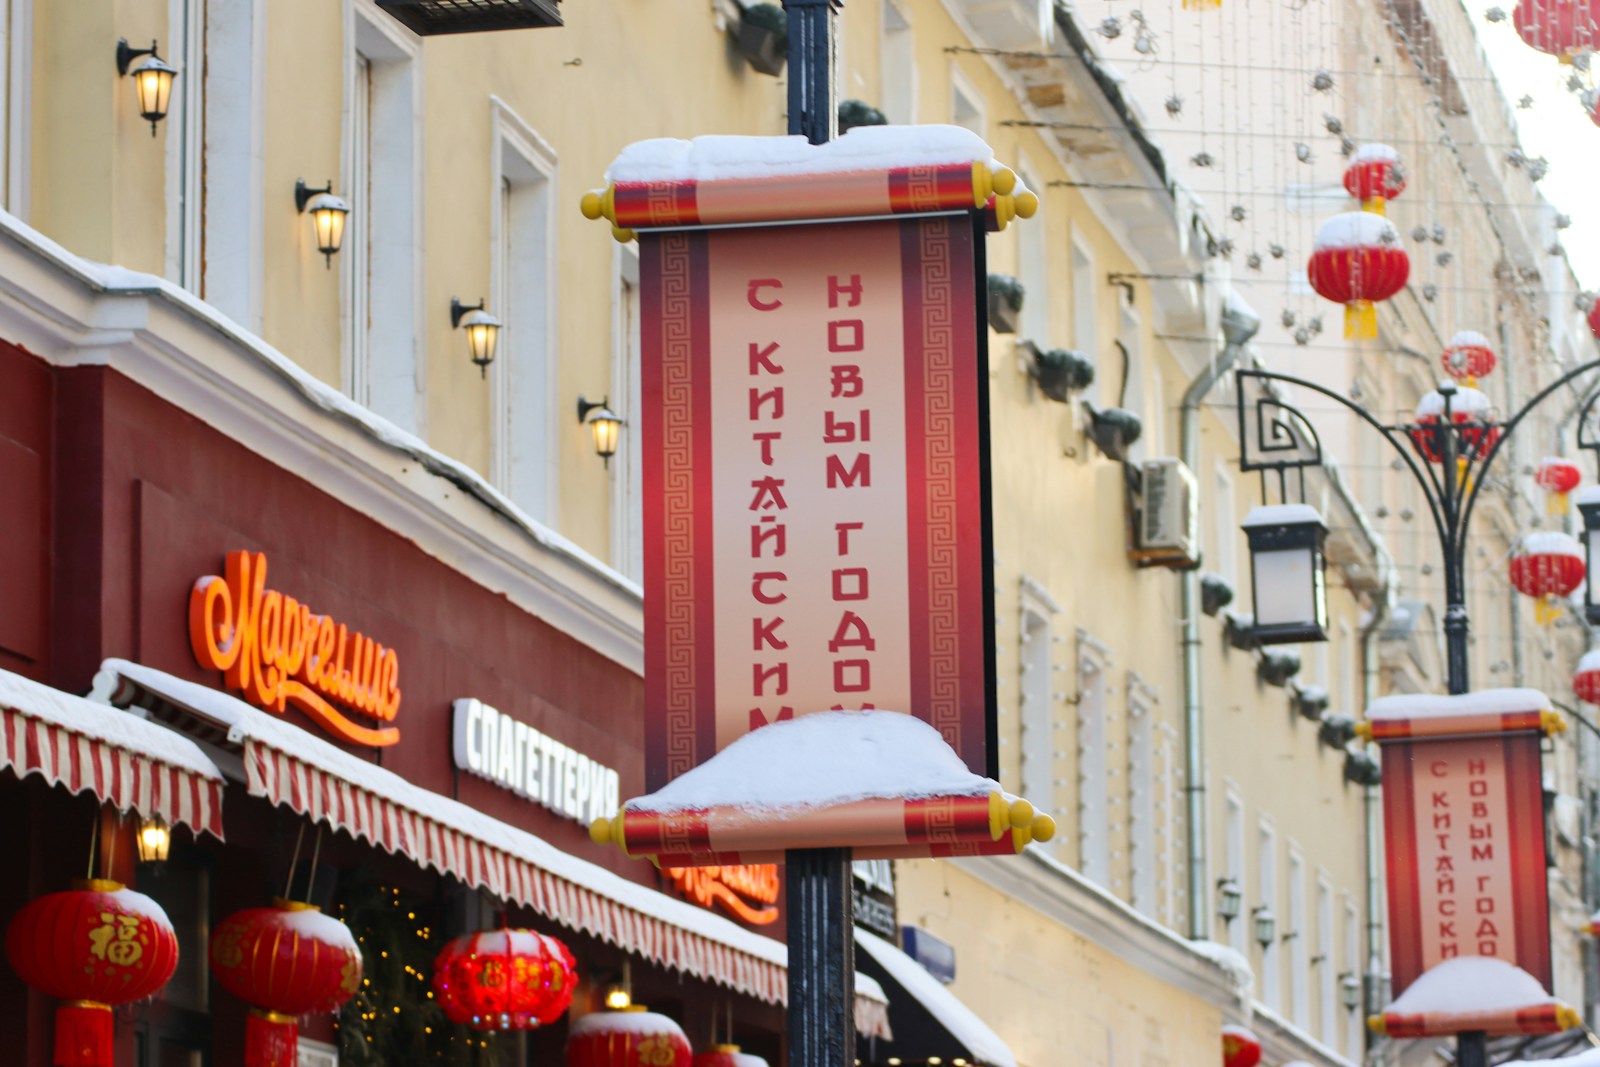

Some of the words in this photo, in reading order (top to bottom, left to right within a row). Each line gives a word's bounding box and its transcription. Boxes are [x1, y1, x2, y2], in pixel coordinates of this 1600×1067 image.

[747, 278, 783, 311] С
[823, 274, 871, 488] НОВЫМ
[828, 521, 876, 714] ГОДО
[454, 697, 619, 827] СПАГЕТТЕРИЯ
[1430, 761, 1448, 778] С
[1468, 758, 1493, 861] НОВЫМ
[1432, 792, 1458, 959] КИТАЙСКИ
[1475, 876, 1498, 957] ГОДО
[88, 912, 143, 966] 福
